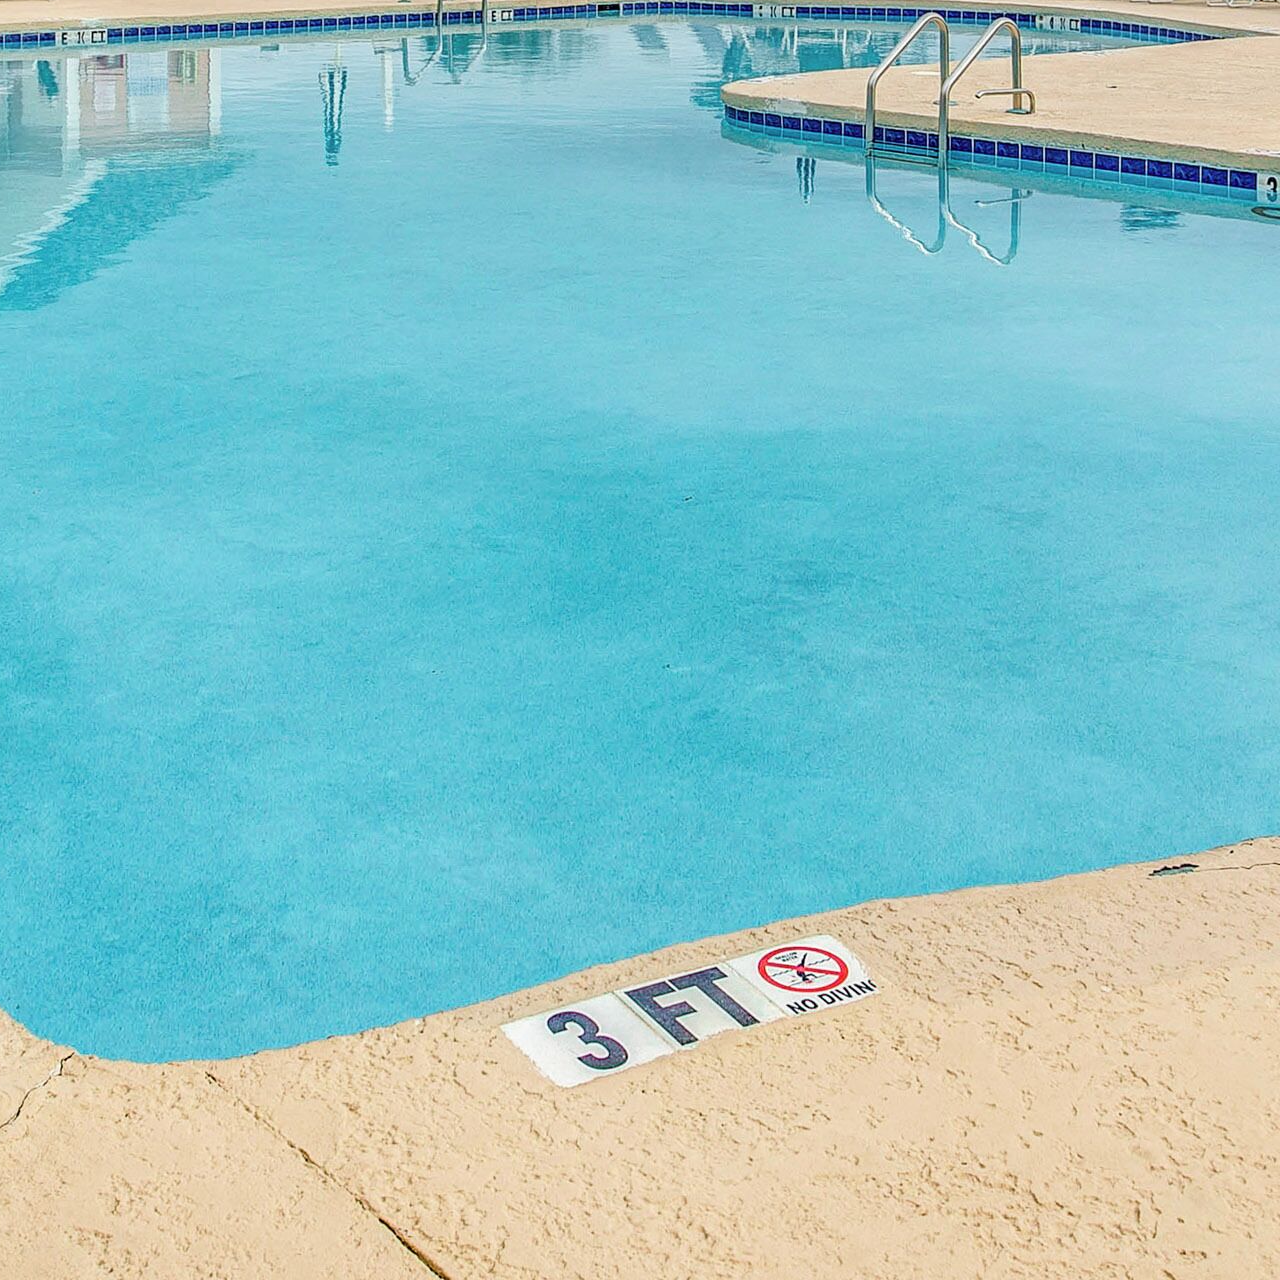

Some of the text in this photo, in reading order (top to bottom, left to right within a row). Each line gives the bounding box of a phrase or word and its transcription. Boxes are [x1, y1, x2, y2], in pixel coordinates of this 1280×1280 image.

[547, 966, 760, 1070] 3 FT
[786, 998, 819, 1014] NO
